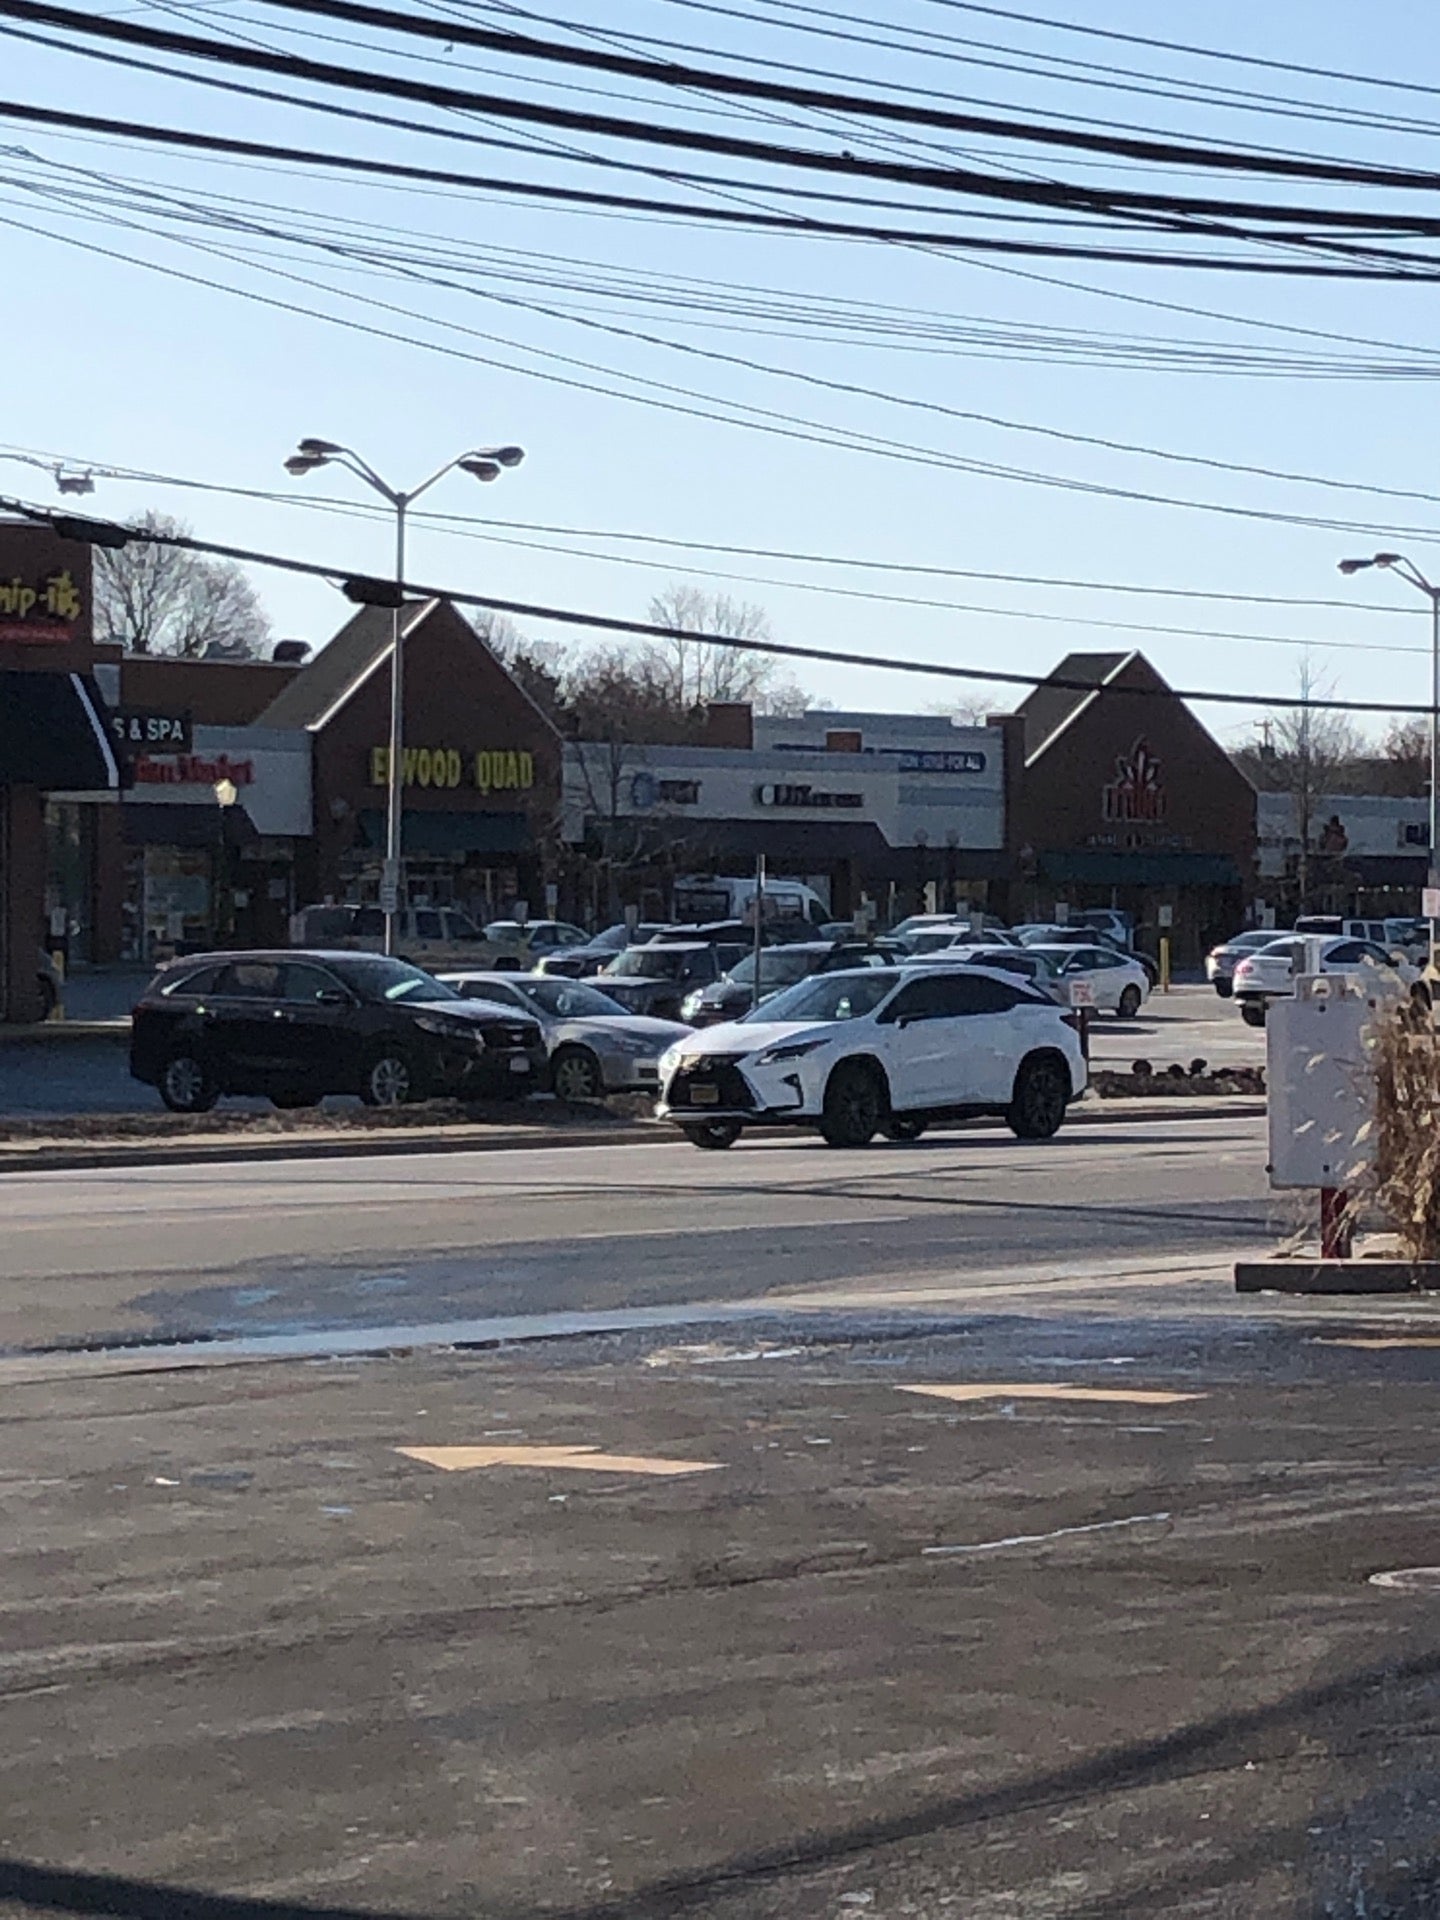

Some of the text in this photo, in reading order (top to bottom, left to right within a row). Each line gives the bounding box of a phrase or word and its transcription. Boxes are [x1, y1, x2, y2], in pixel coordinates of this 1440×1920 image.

[129, 717, 142, 741] &
[146, 717, 184, 742] SPA
[372, 747, 534, 796] EWOOD QUAD
